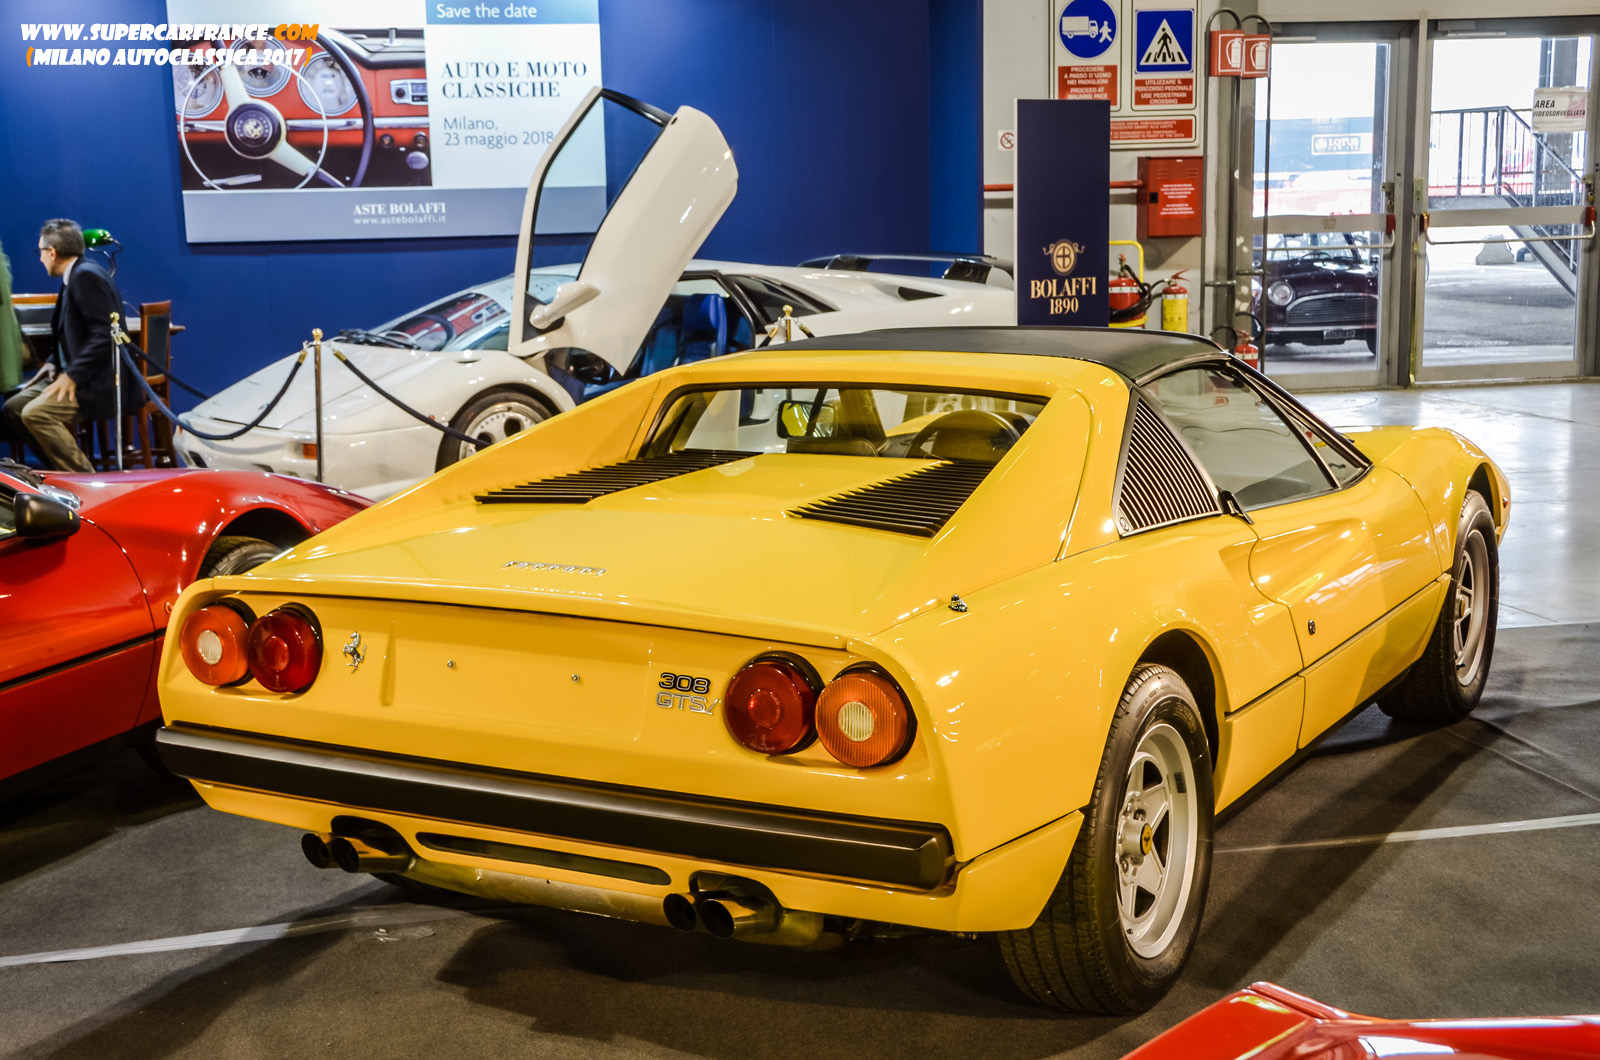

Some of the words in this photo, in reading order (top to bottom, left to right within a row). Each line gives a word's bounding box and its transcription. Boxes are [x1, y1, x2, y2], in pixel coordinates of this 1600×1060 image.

[436, 4, 471, 18] Save
[475, 3, 500, 18] the
[504, 3, 538, 18] date
[441, 62, 500, 78] AUTO
[507, 61, 520, 78] E
[526, 61, 587, 78] MOTO
[442, 81, 560, 99] CLASSICHE
[1534, 100, 1555, 108] AREA
[443, 116, 499, 131] Milano,
[444, 132, 460, 146] 23
[465, 131, 518, 149] maggio
[523, 131, 554, 145] 2018
[353, 203, 387, 215] ASTE
[389, 202, 446, 215] BOLAFFI
[353, 214, 446, 225] www.astebolaffi.it
[1030, 276, 1097, 299] BOLAFFI
[1049, 297, 1079, 315] 1890
[658, 672, 711, 694] 308
